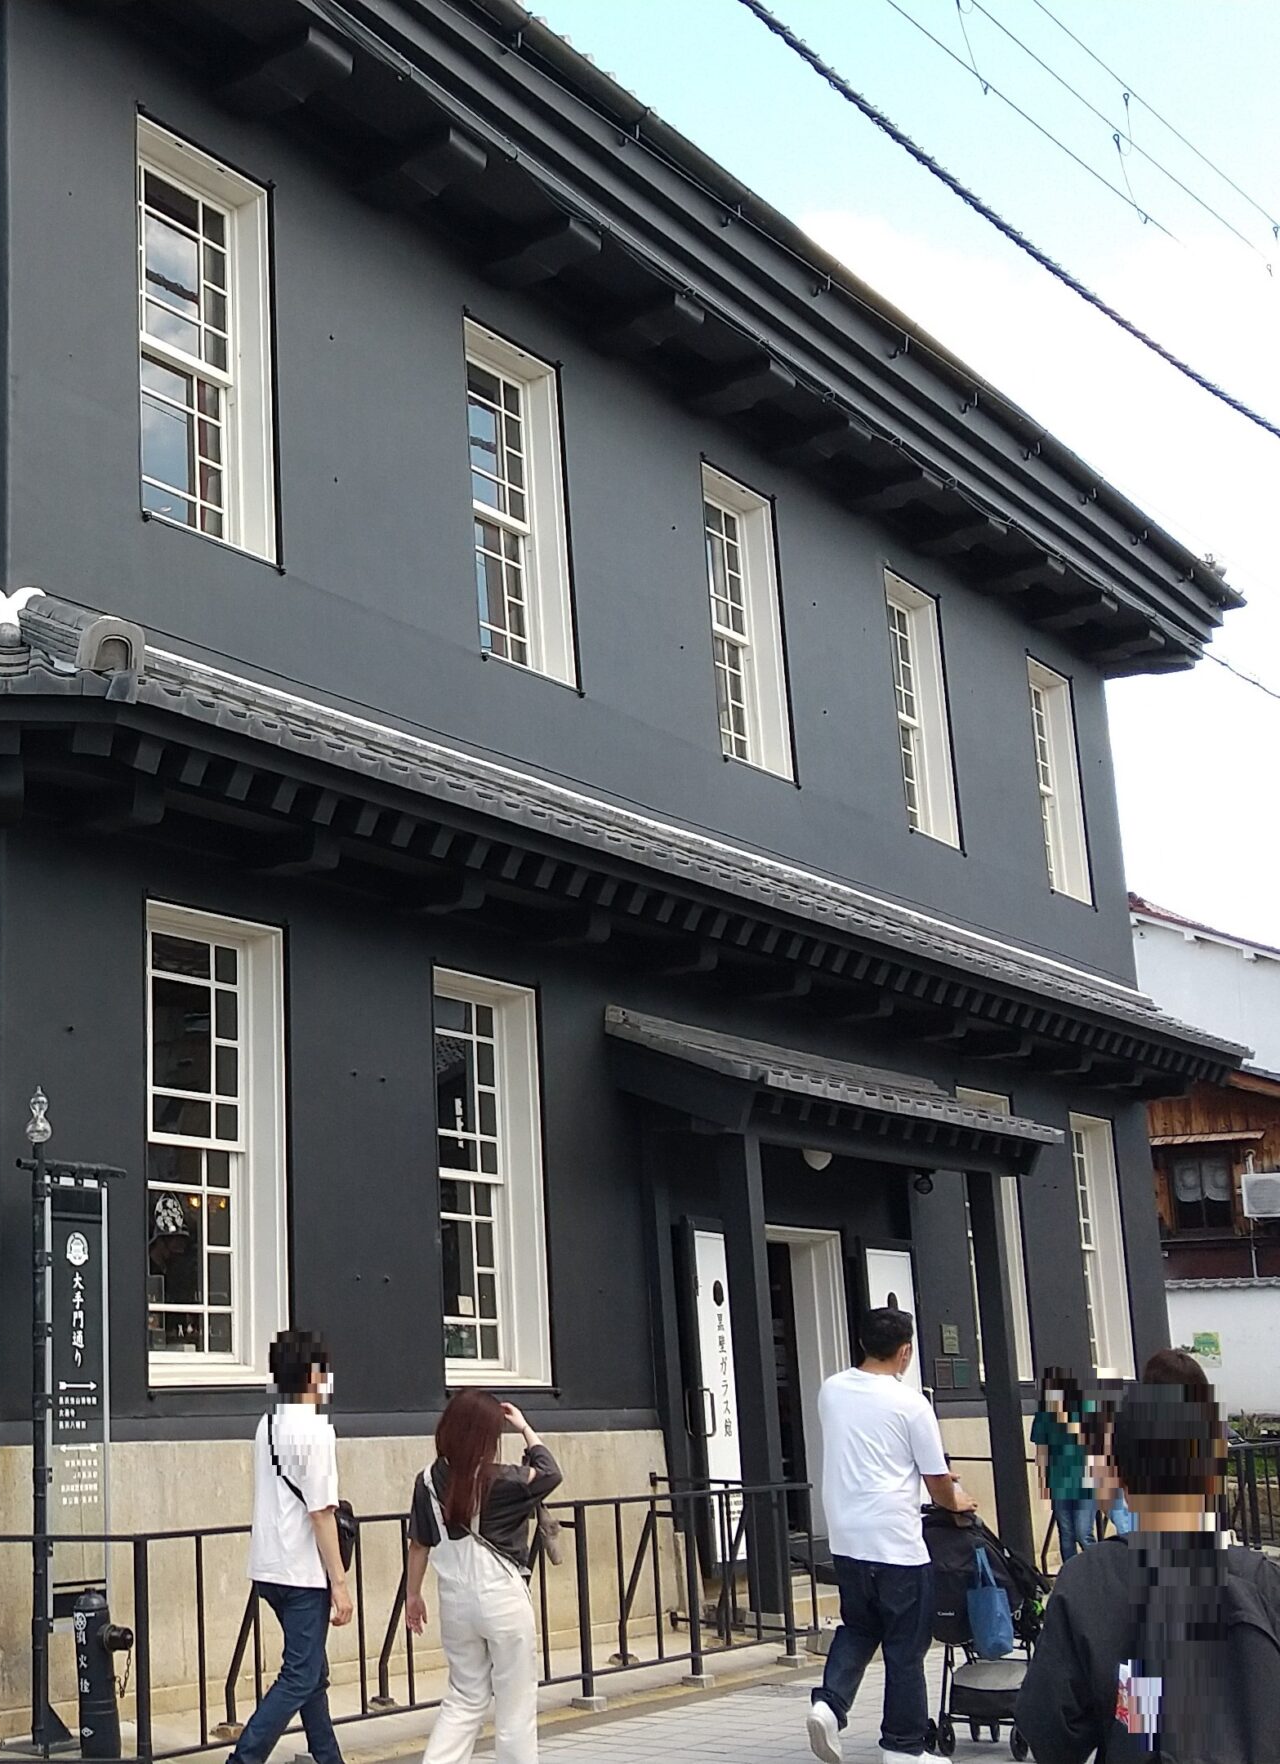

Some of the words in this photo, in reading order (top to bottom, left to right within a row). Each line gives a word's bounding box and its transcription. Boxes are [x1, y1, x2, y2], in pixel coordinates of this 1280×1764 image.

[72, 1271, 85, 1368] 大手門通り
[717, 1313, 732, 1437] 黒壁ガラス館
